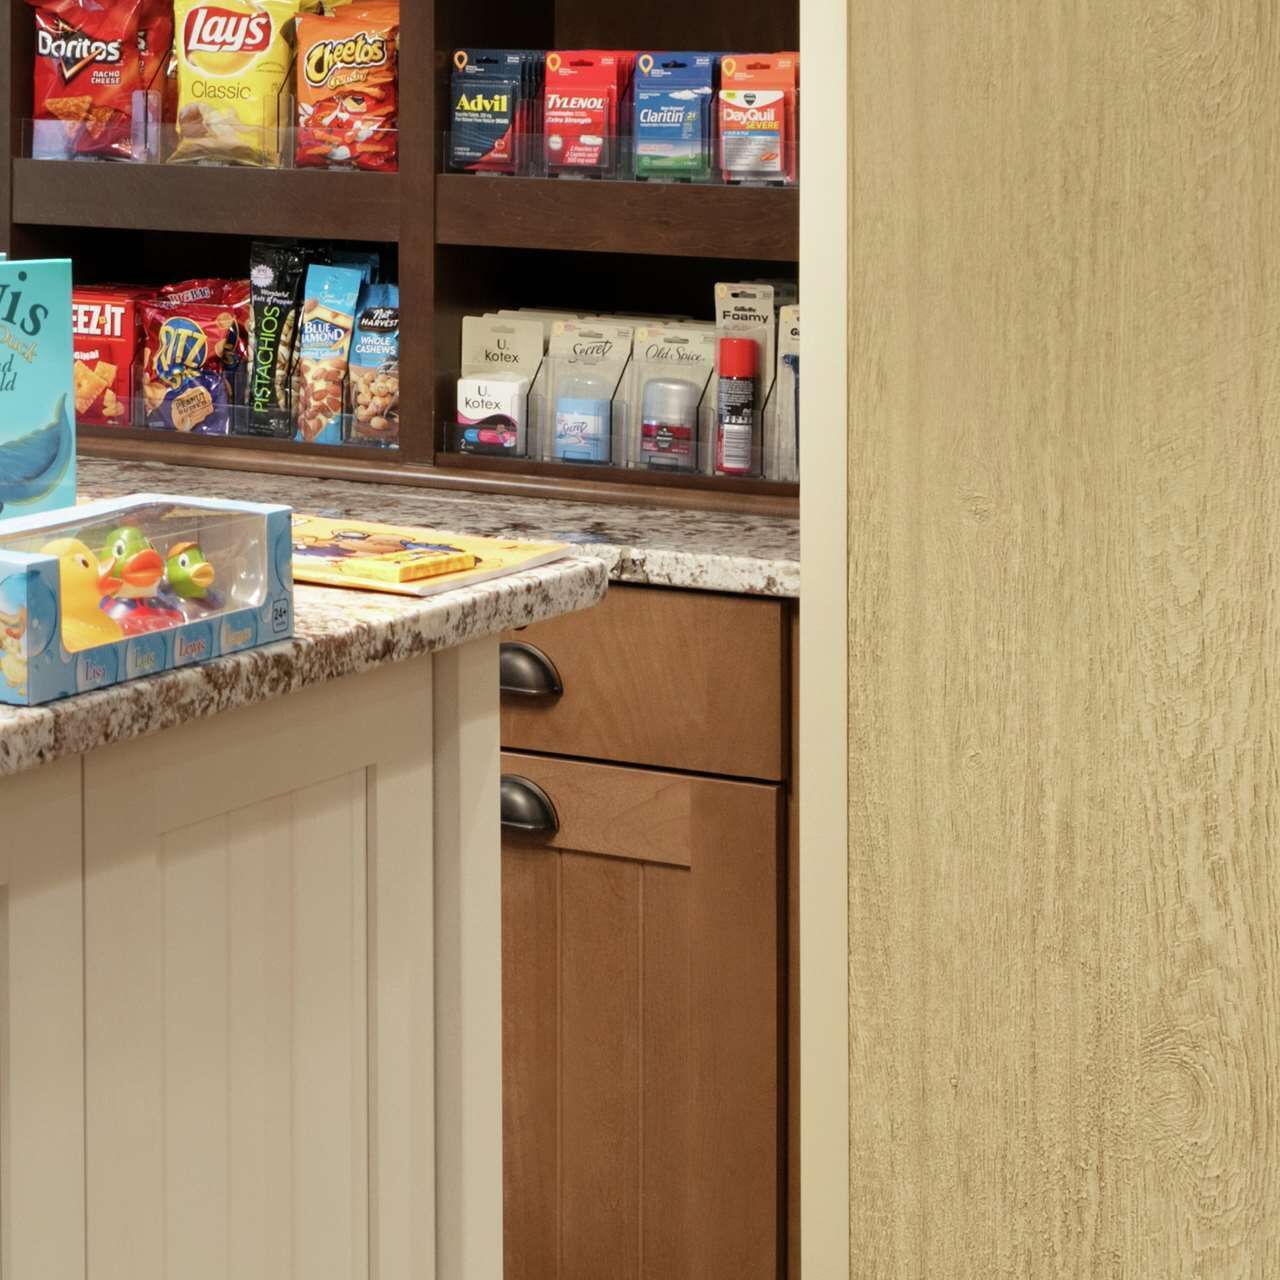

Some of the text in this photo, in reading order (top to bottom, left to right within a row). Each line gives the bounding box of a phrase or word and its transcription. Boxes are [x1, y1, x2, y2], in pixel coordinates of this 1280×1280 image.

[187, 8, 269, 53] Lay's
[38, 30, 121, 61] Doritos
[305, 33, 385, 84] Cheetos
[191, 79, 252, 100] Classic
[455, 93, 508, 113] Advil
[545, 93, 604, 109] TYLENOL
[640, 108, 684, 124] Claritin
[723, 108, 775, 125] DayQuil
[746, 121, 778, 129] SEVERE
[373, 308, 392, 318] Nut
[722, 310, 769, 324] Foamy
[304, 321, 331, 334] BLUE
[361, 318, 399, 328] HARVEST
[155, 324, 208, 372] RITZ
[360, 336, 391, 345] WHOLE
[355, 344, 397, 355] CASHEWS
[645, 344, 702, 362] Old Spice
[253, 305, 280, 413] PISTACHIOS
[274, 607, 288, 619] 24+
